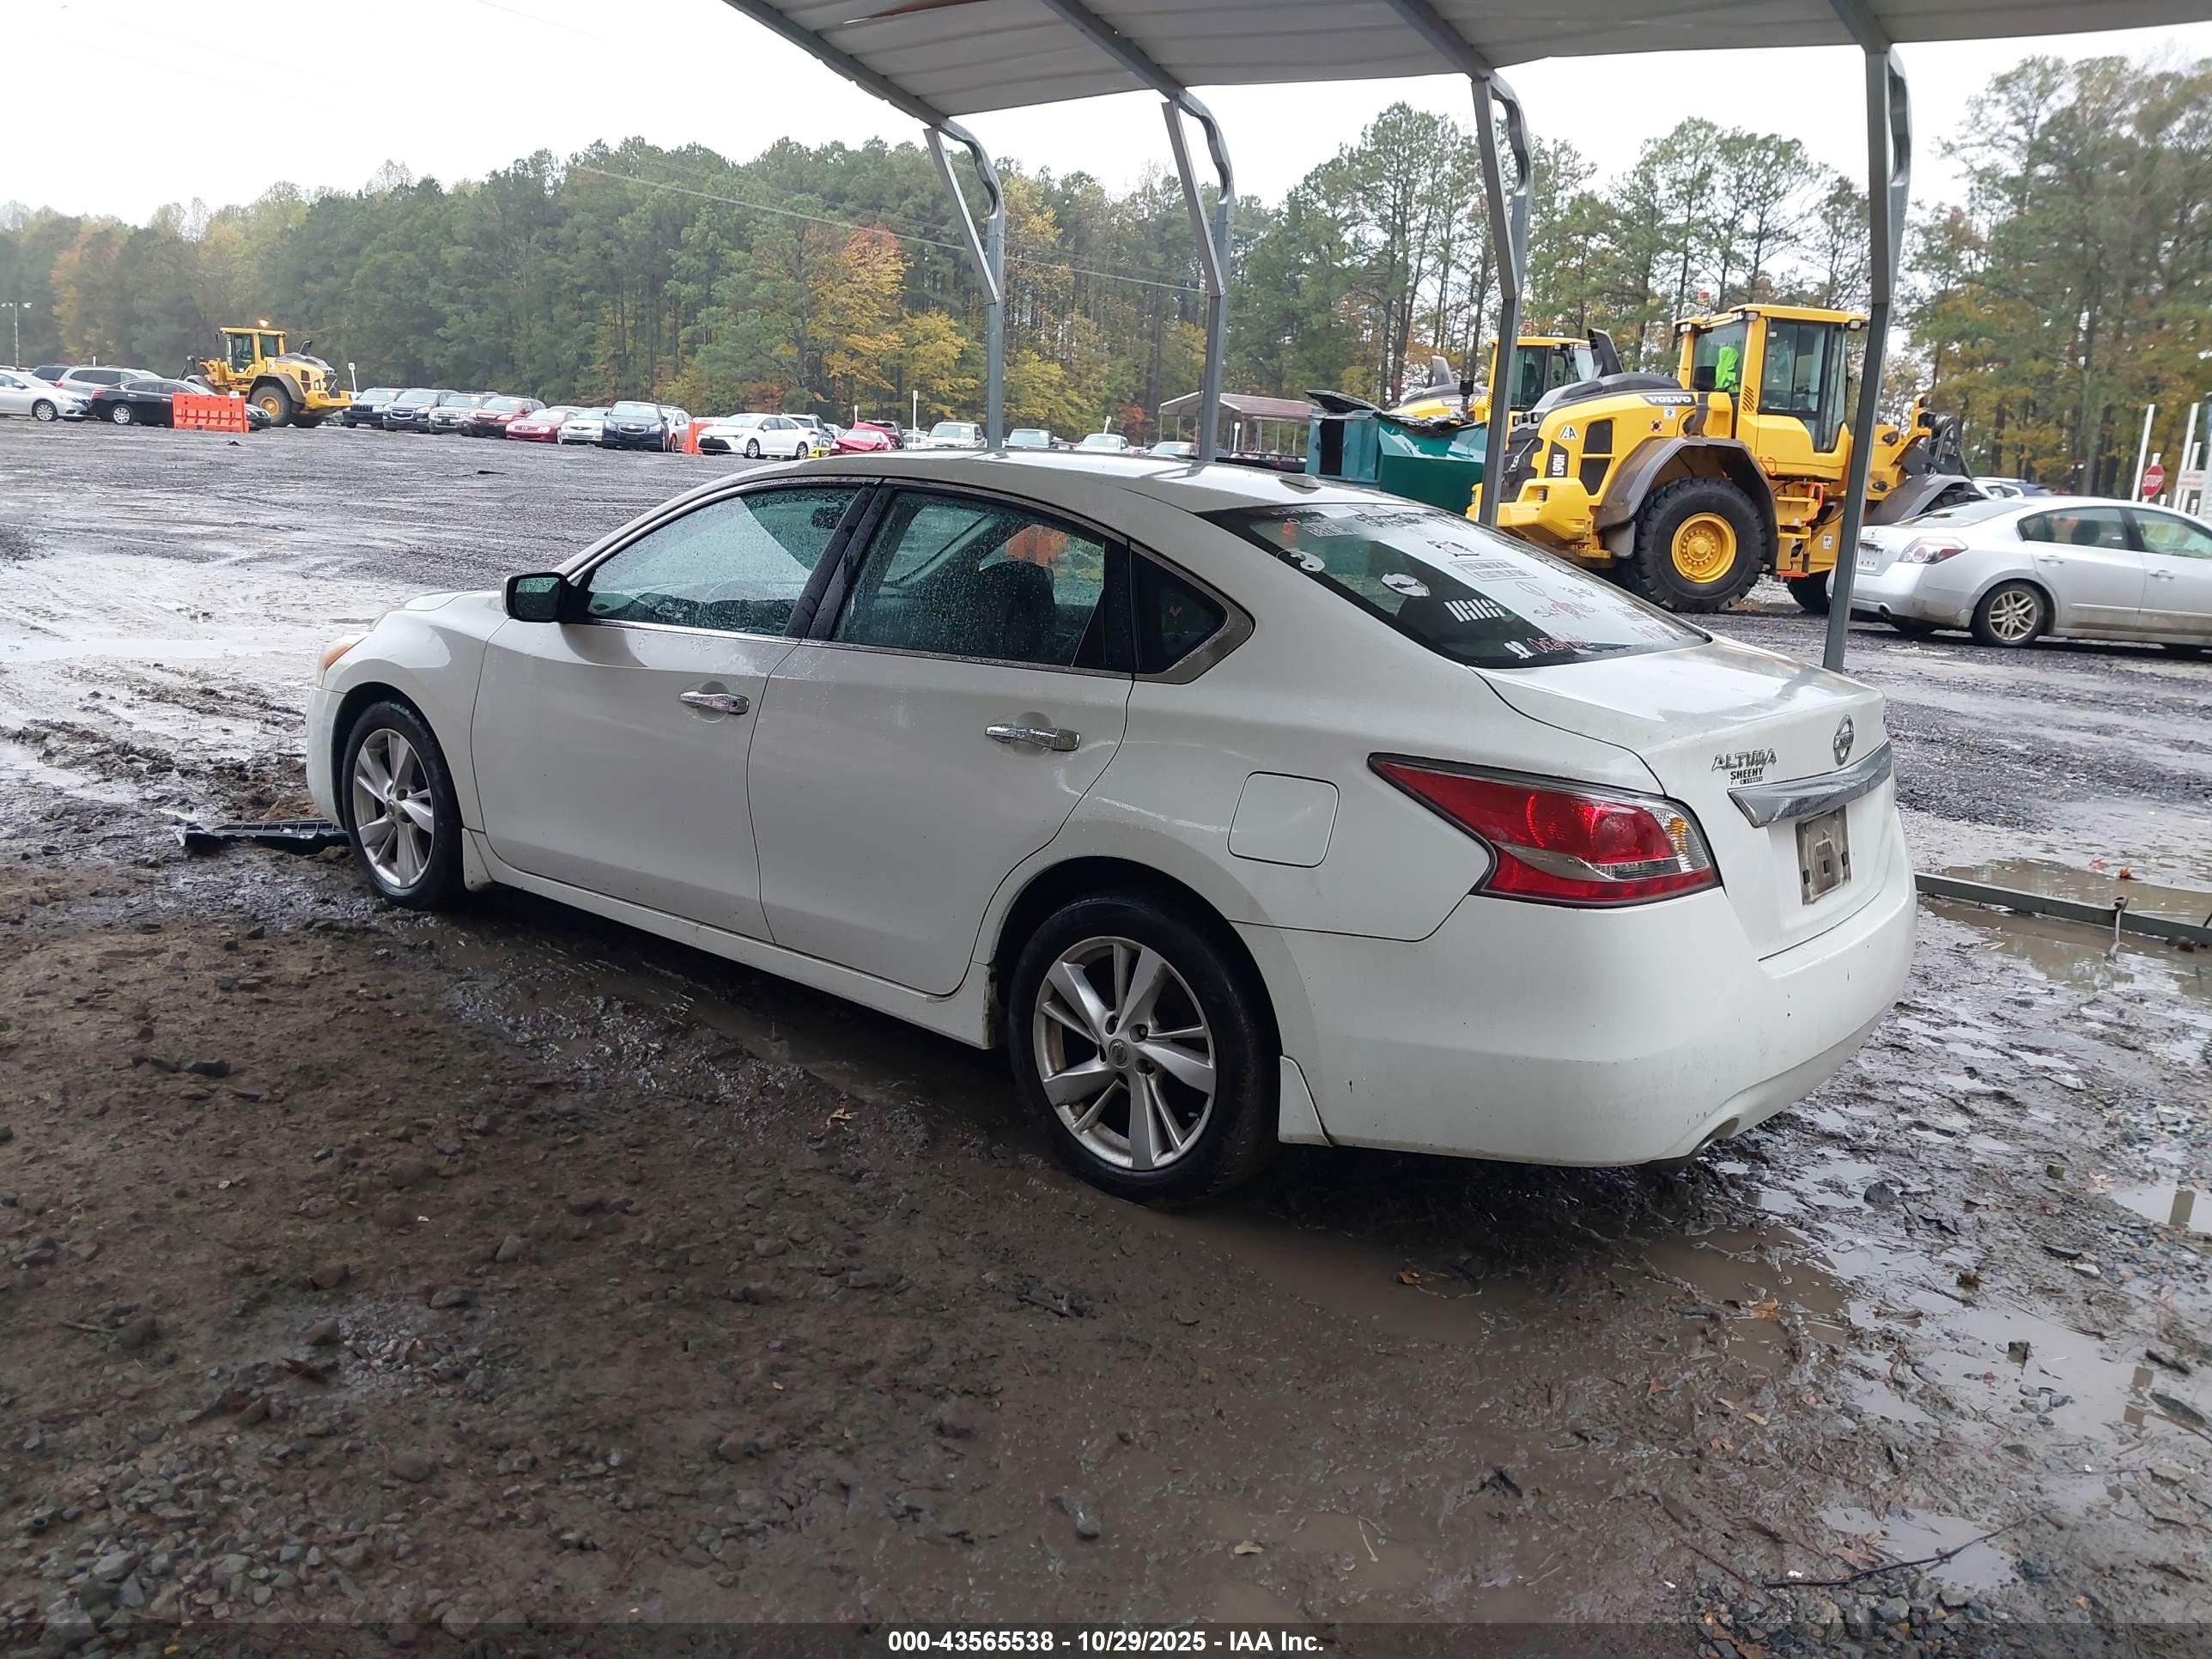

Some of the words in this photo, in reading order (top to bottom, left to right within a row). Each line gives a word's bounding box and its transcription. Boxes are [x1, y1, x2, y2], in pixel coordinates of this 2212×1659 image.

[1552, 453, 1566, 477] L90H
[2142, 475, 2164, 488] STOP
[1711, 748, 1778, 771] ALTIMA
[1729, 767, 1764, 780] SHEEHY
